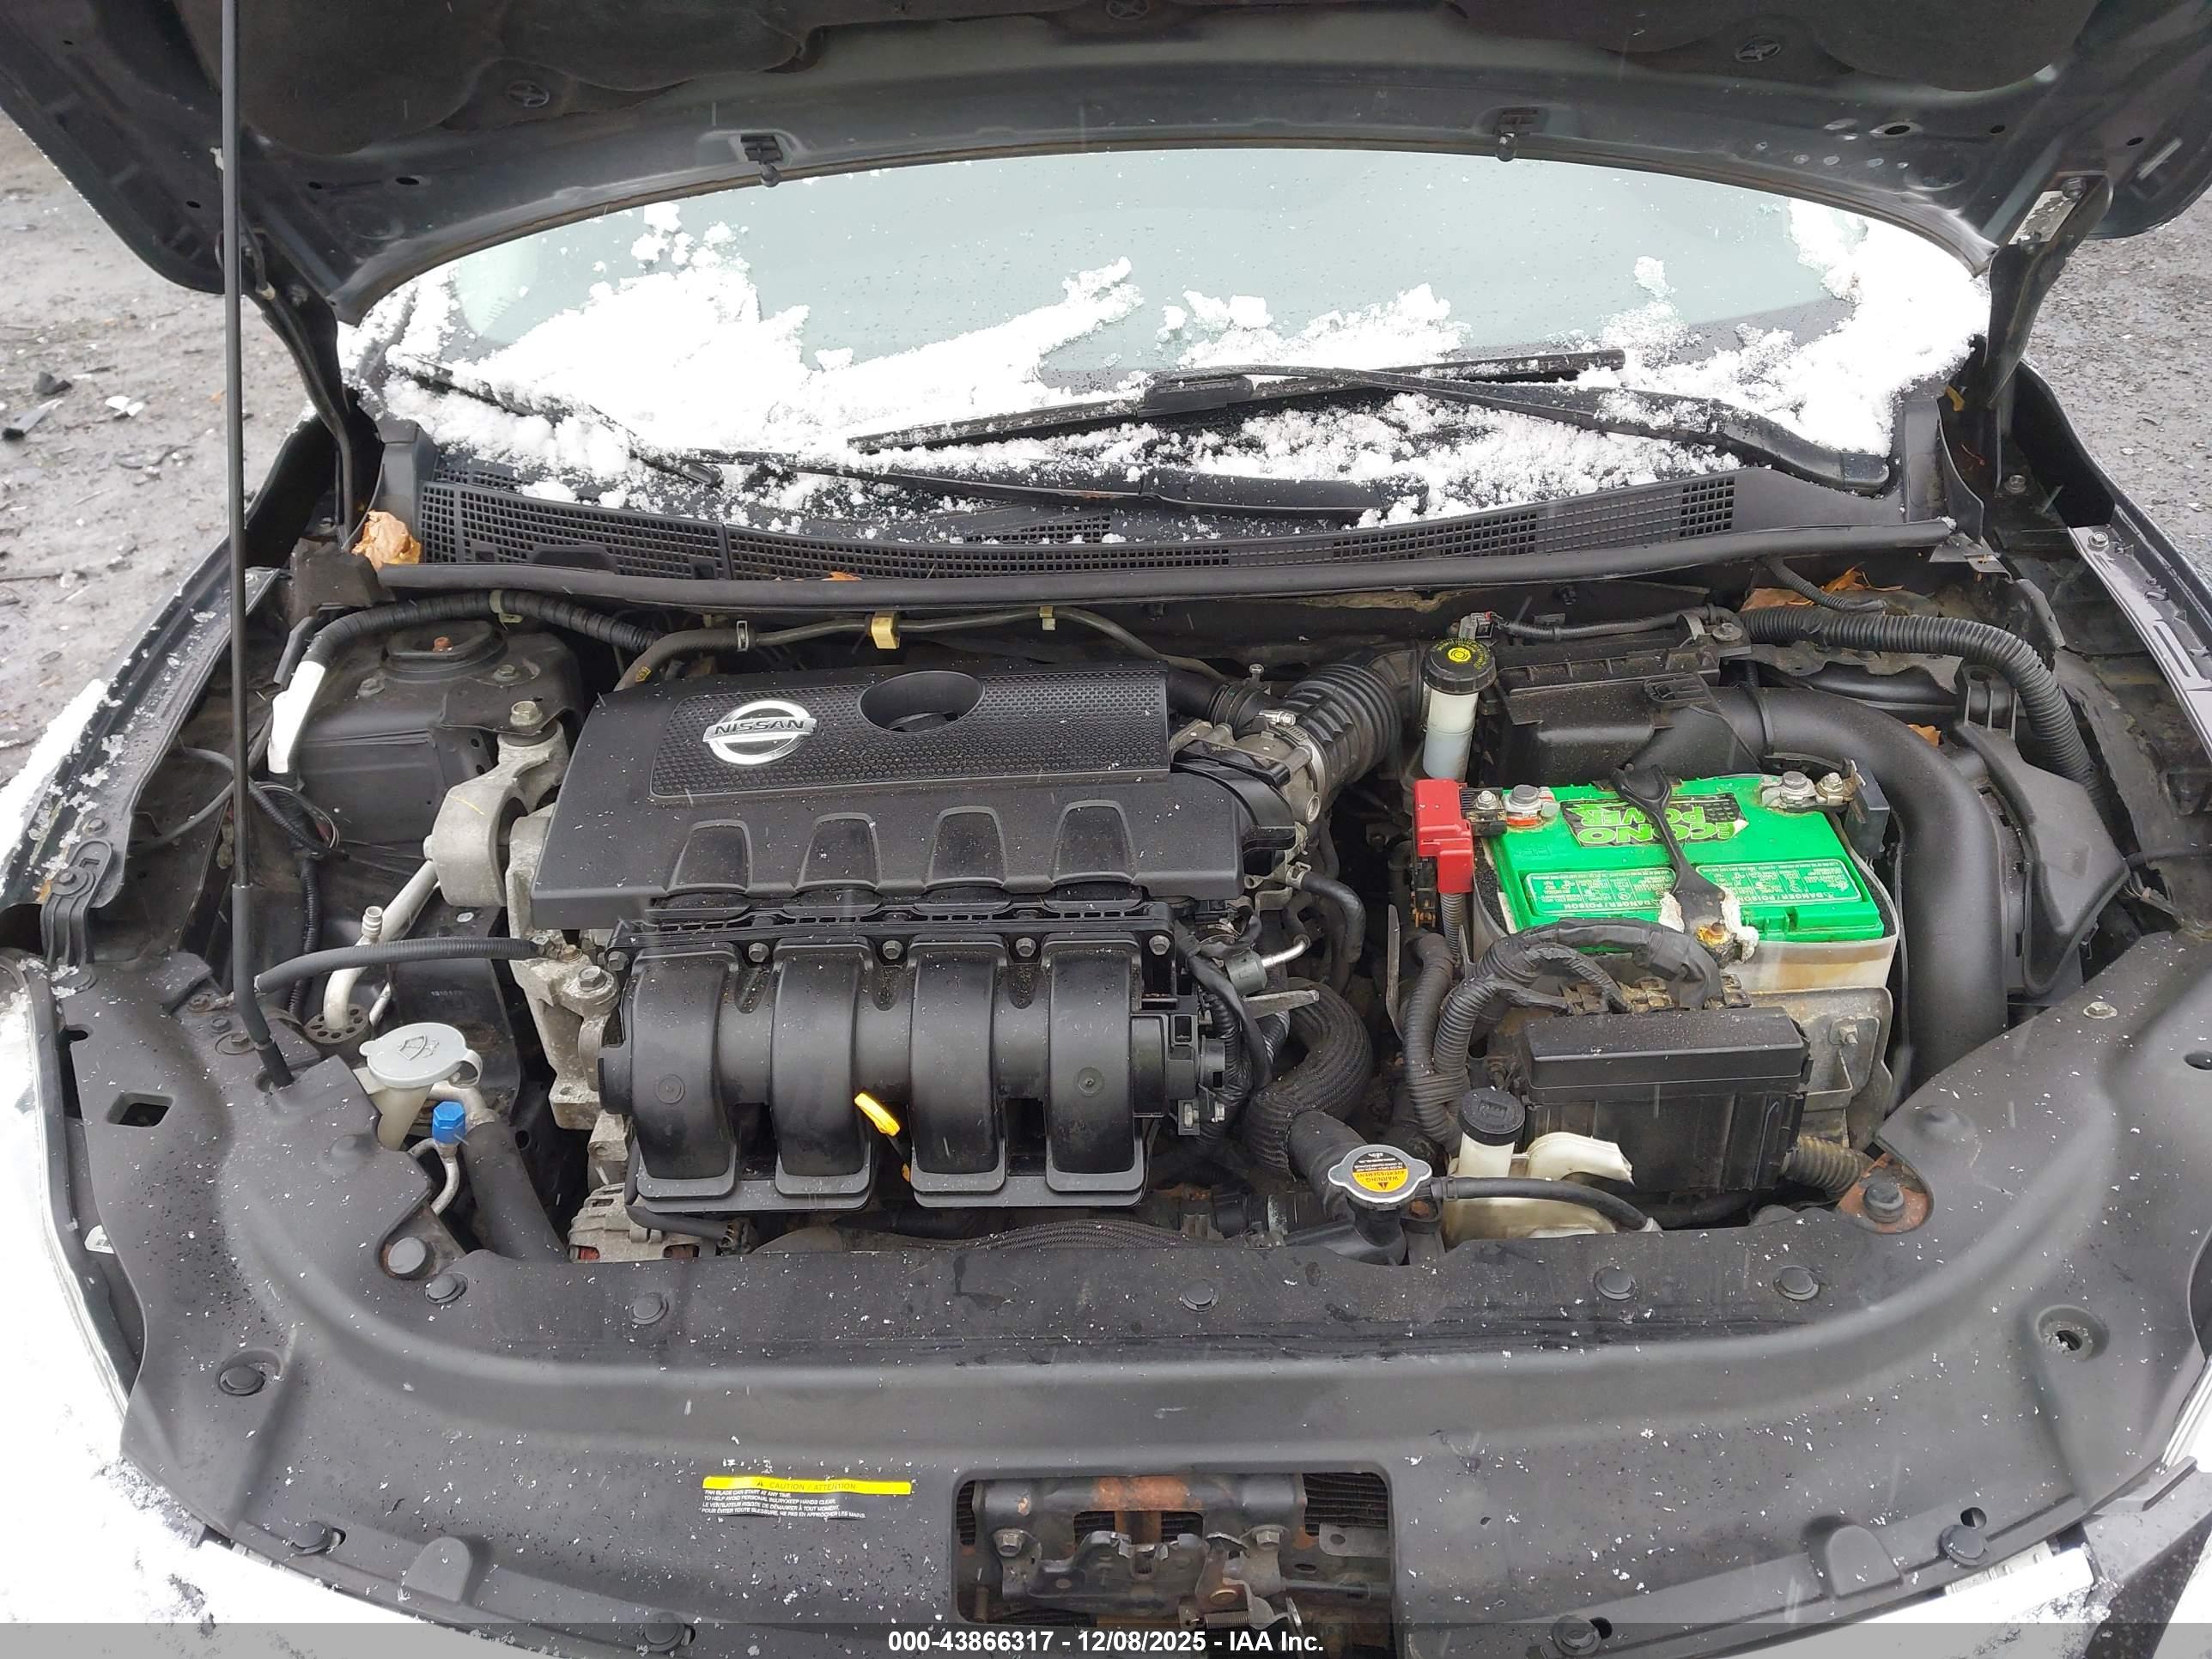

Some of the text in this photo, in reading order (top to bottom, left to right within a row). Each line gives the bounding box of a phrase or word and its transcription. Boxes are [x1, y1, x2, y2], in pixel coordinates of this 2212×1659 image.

[714, 720, 805, 735] NISSAN
[1580, 805, 1706, 827] POWER
[1577, 822, 1735, 844] ECONO
